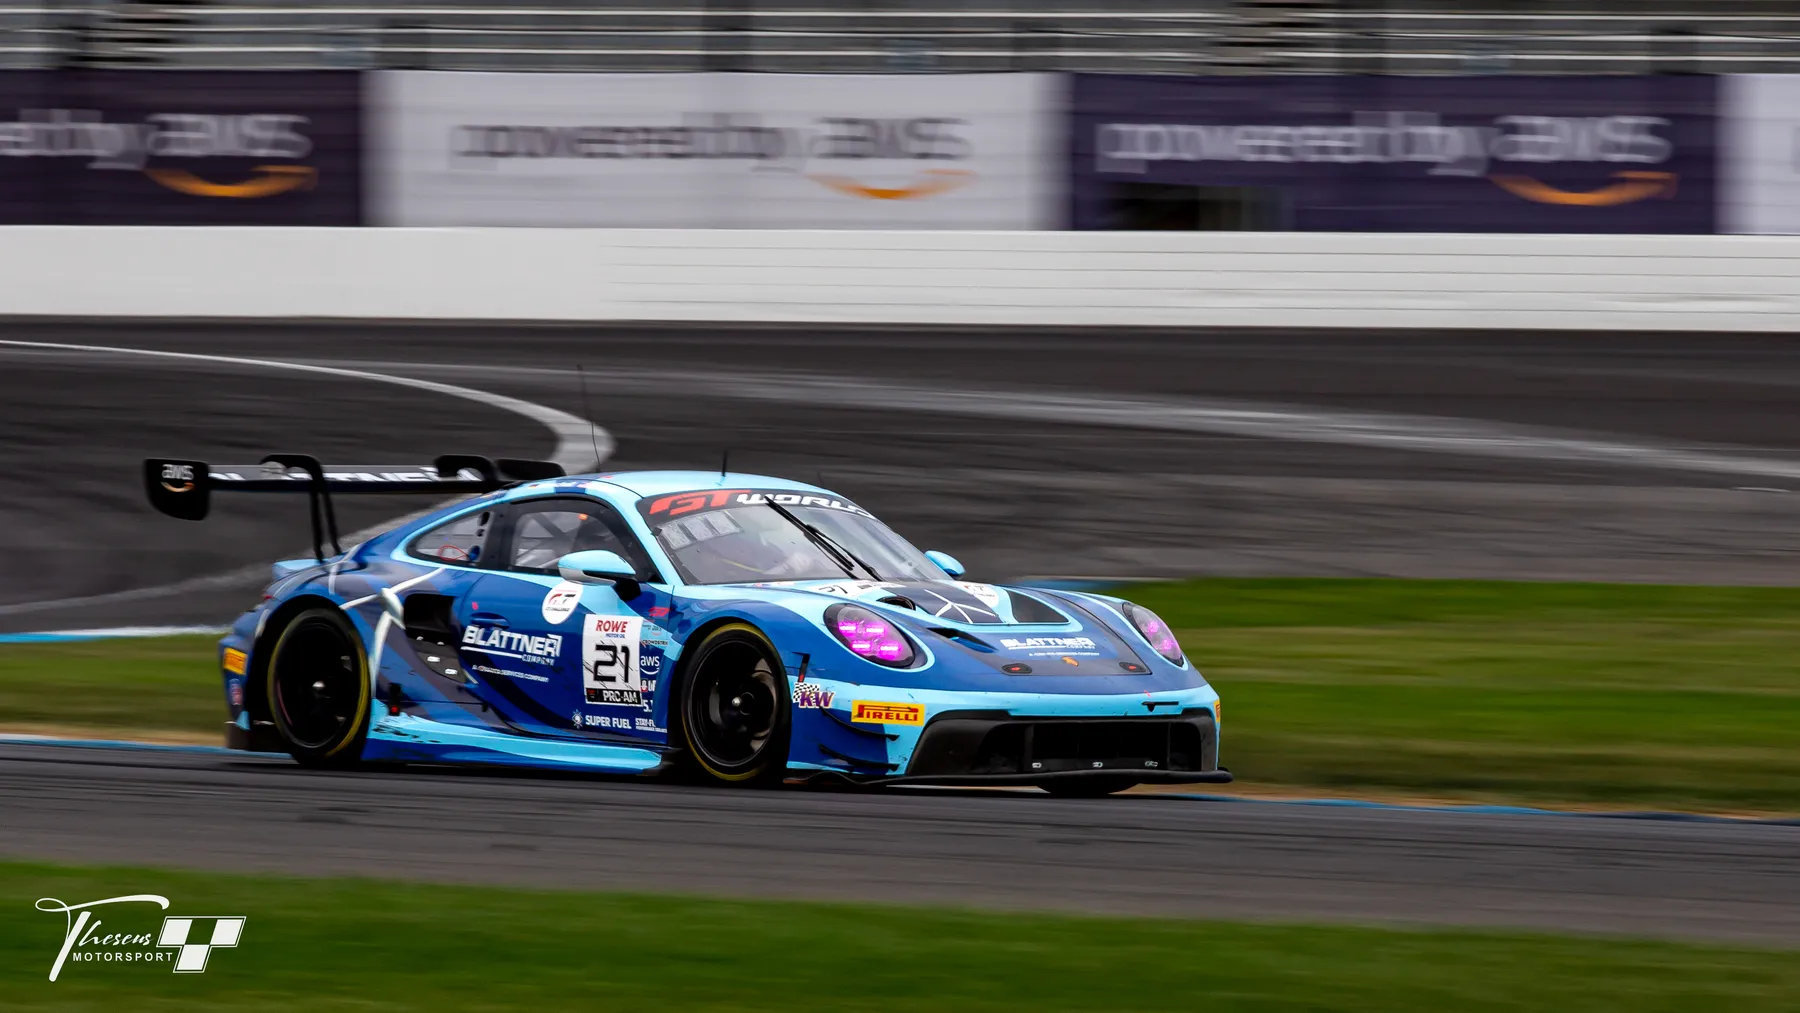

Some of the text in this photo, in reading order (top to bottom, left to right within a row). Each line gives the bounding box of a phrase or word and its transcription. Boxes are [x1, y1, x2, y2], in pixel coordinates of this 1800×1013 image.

[595, 619, 628, 633] ROWE
[462, 625, 563, 657] BLATTNER
[593, 643, 630, 683] 21
[640, 655, 660, 666] aws
[799, 691, 834, 708] KW
[857, 704, 919, 721] PIRELLI
[585, 714, 611, 727] SUPER
[612, 717, 632, 729] FUEL
